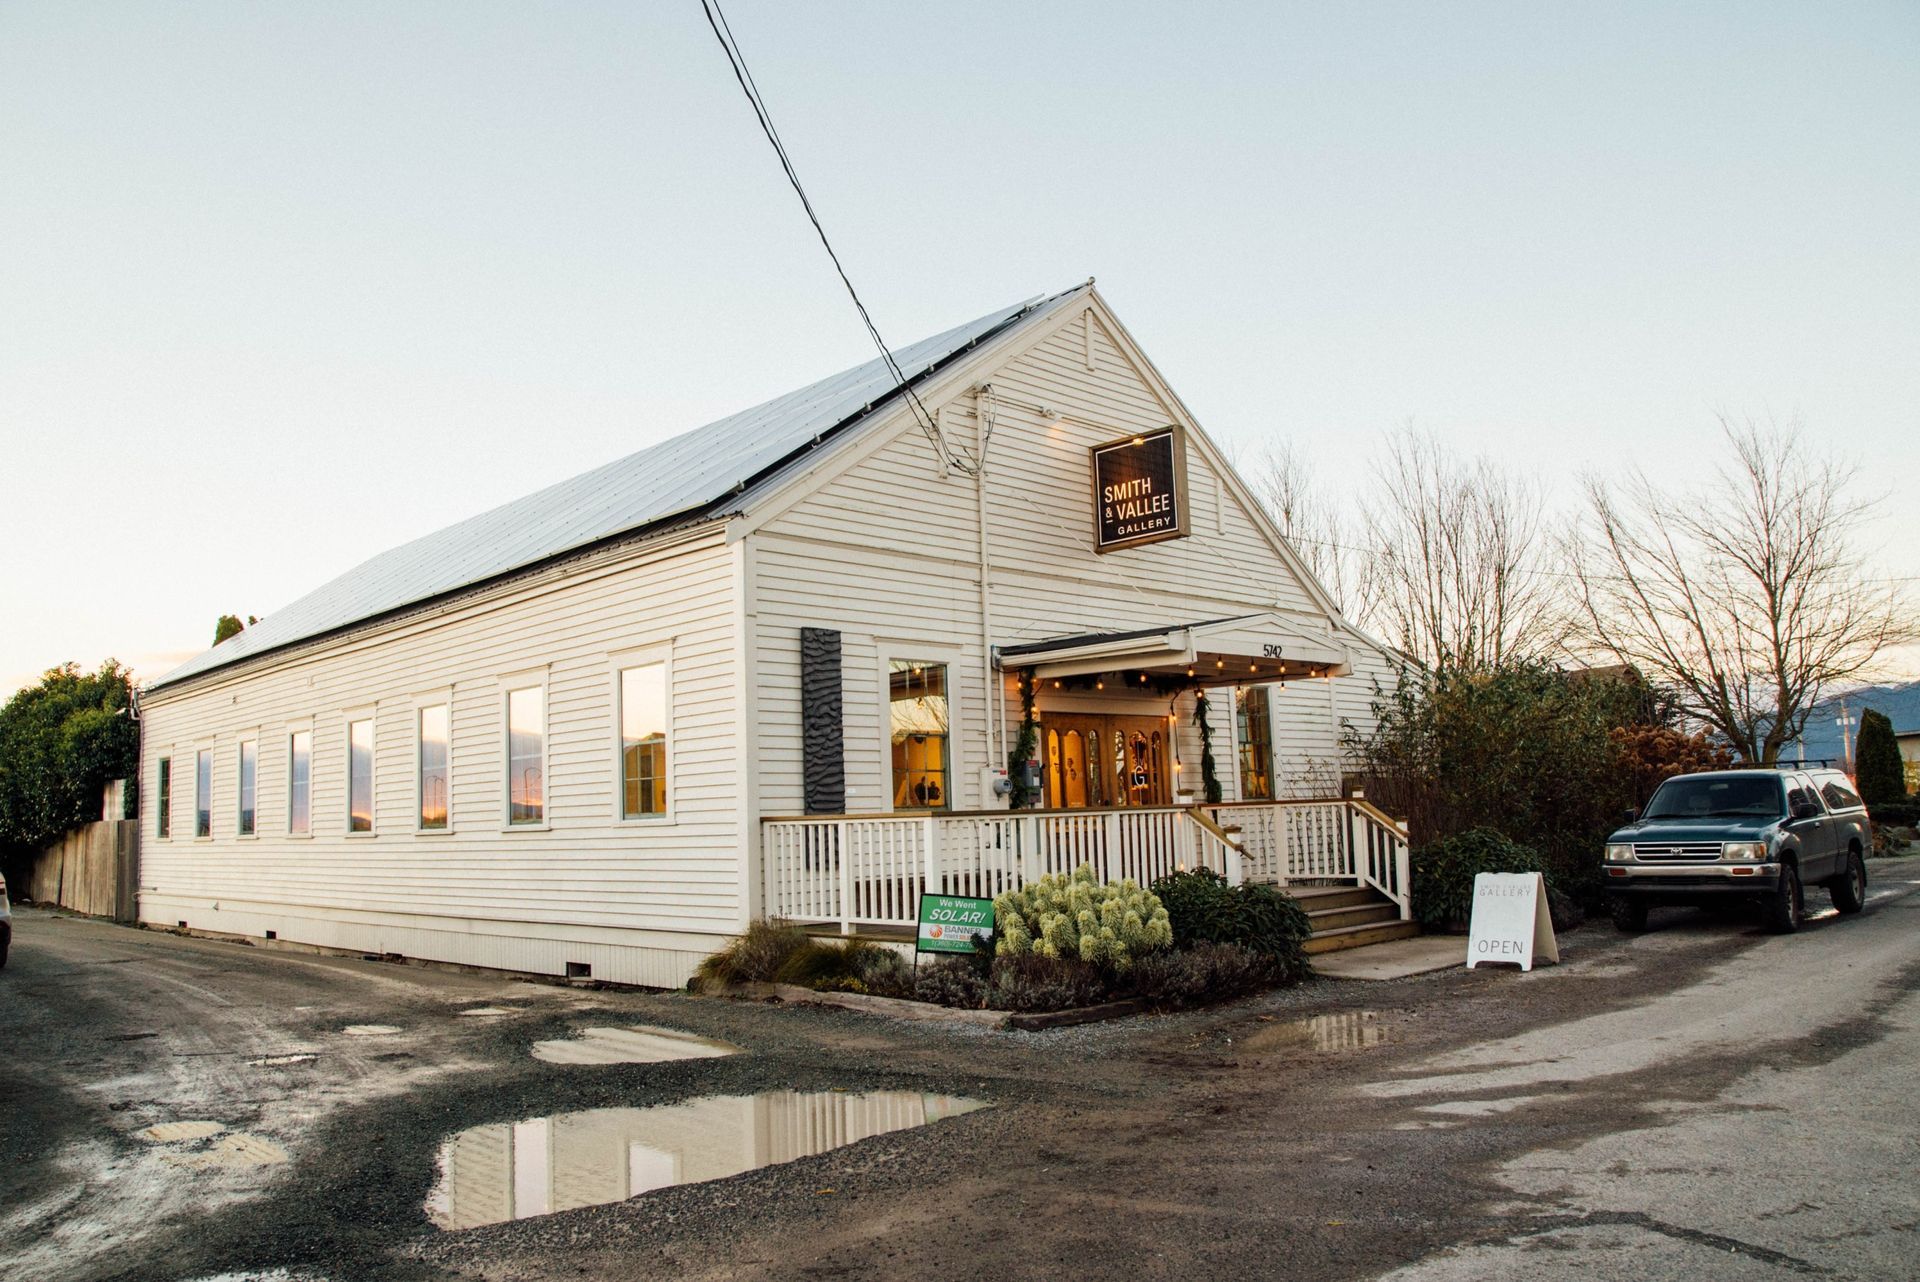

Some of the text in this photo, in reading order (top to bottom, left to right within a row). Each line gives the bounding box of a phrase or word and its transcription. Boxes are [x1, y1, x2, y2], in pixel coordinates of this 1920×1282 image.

[1104, 477, 1151, 503] SMITH
[1105, 493, 1170, 520] & VALLEE
[1117, 516, 1171, 535] GALLERY
[1263, 644, 1282, 659] 5742
[1134, 765, 1145, 787] G
[1479, 888, 1531, 897] GALLERY
[939, 899, 977, 909] We Went
[929, 908, 986, 923] SOLAR!
[944, 925, 982, 935] BANNER
[1478, 939, 1523, 954] OPEN
